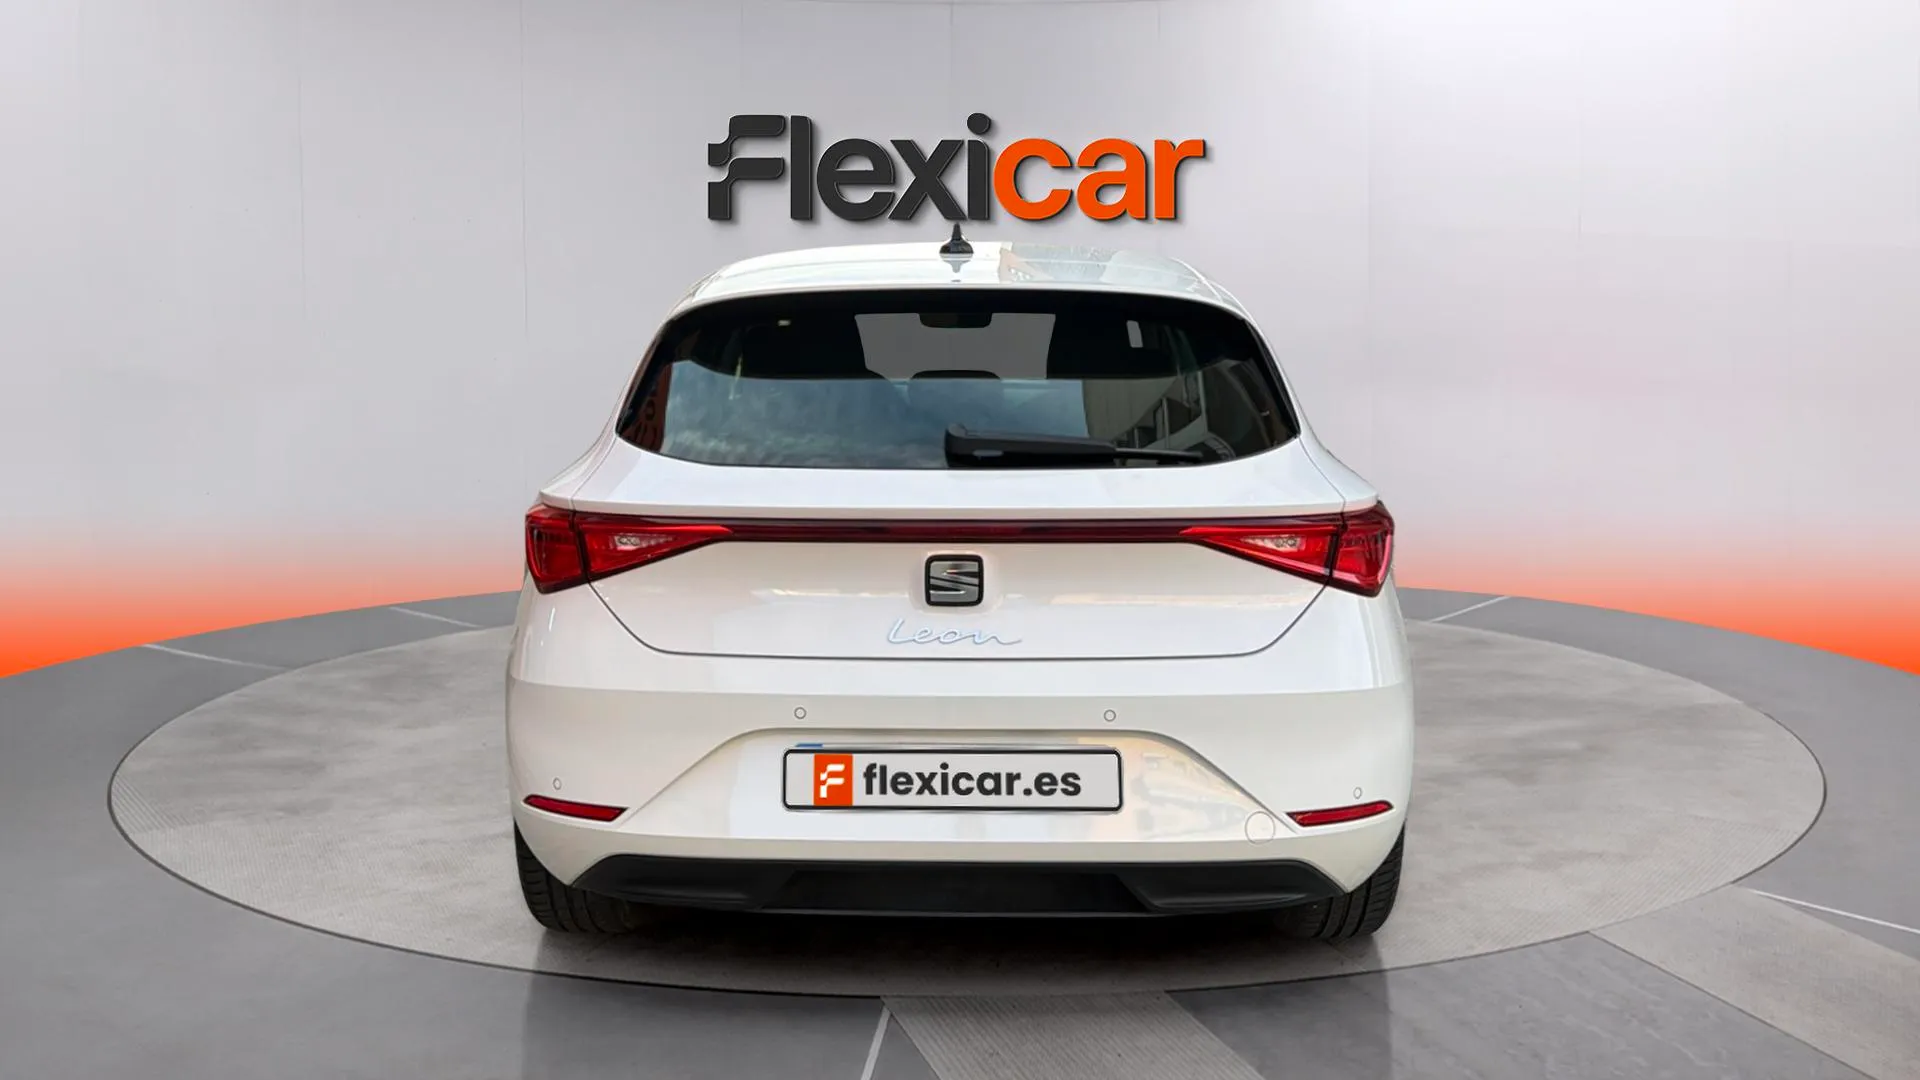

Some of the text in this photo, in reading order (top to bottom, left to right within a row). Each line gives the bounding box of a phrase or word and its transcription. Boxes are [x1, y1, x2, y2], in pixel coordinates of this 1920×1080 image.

[707, 112, 1206, 221] Flexicar
[887, 617, 1022, 645] Leon
[863, 762, 1083, 797] flexicar.es
